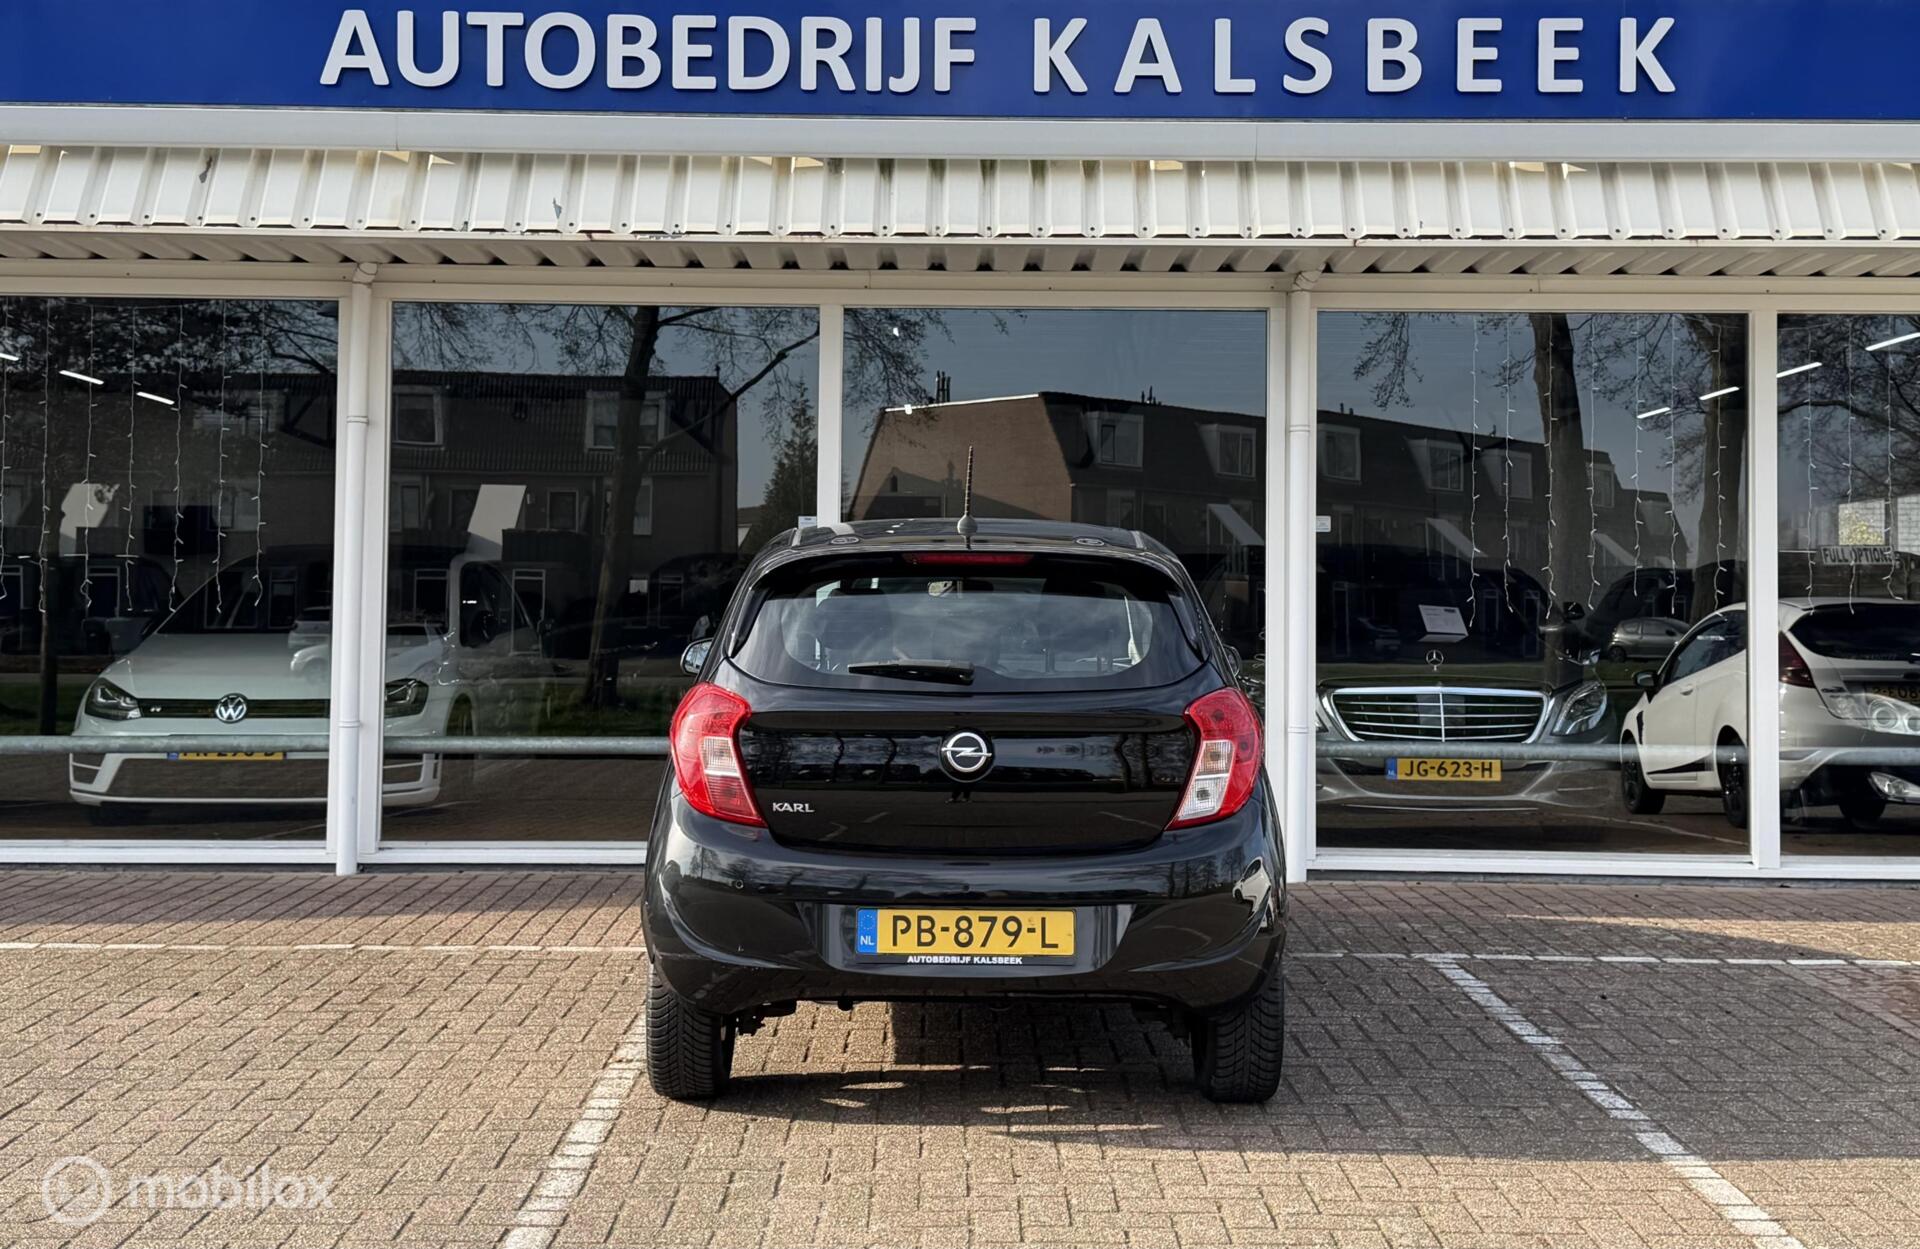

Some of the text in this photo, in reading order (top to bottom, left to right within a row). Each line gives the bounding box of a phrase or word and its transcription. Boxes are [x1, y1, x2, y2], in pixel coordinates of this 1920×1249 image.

[319, 9, 1676, 94] AUTOBEDRIJF KALSBEEK
[1823, 547, 1849, 562] FULL
[1404, 760, 1493, 779] JG-623-H
[772, 802, 815, 813] KARL
[892, 914, 1059, 949] PB-879-L
[860, 935, 874, 946] NL
[907, 955, 1023, 965] AUTOBEDRIJF KALSBEEK
